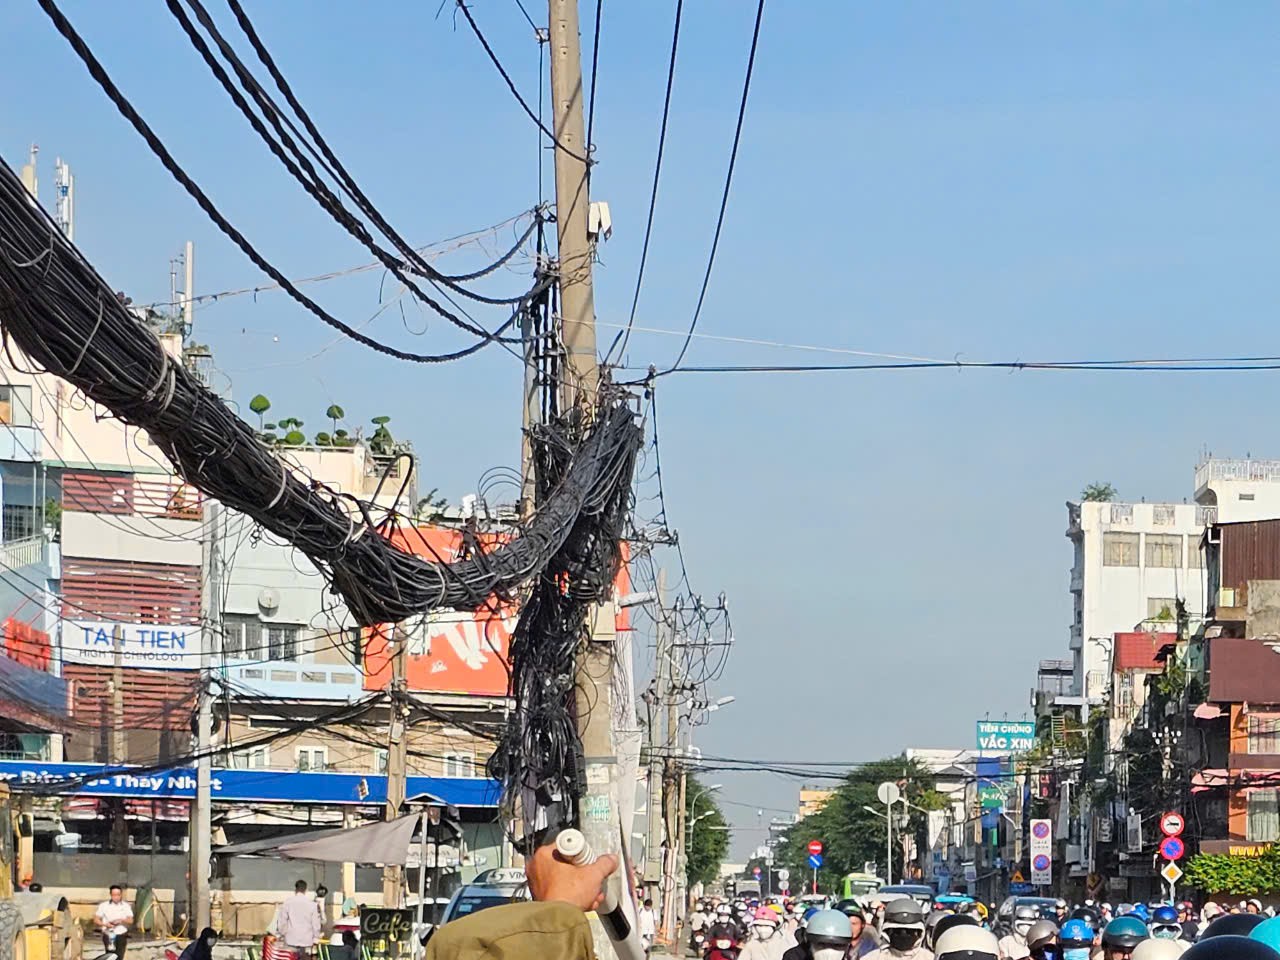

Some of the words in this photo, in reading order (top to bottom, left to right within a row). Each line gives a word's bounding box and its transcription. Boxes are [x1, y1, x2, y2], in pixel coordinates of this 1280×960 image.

[110, 650, 185, 662] TCHNOLOGY
[1010, 738, 1032, 749] XIN
[114, 774, 163, 791] Thay
[168, 776, 222, 791] Nht
